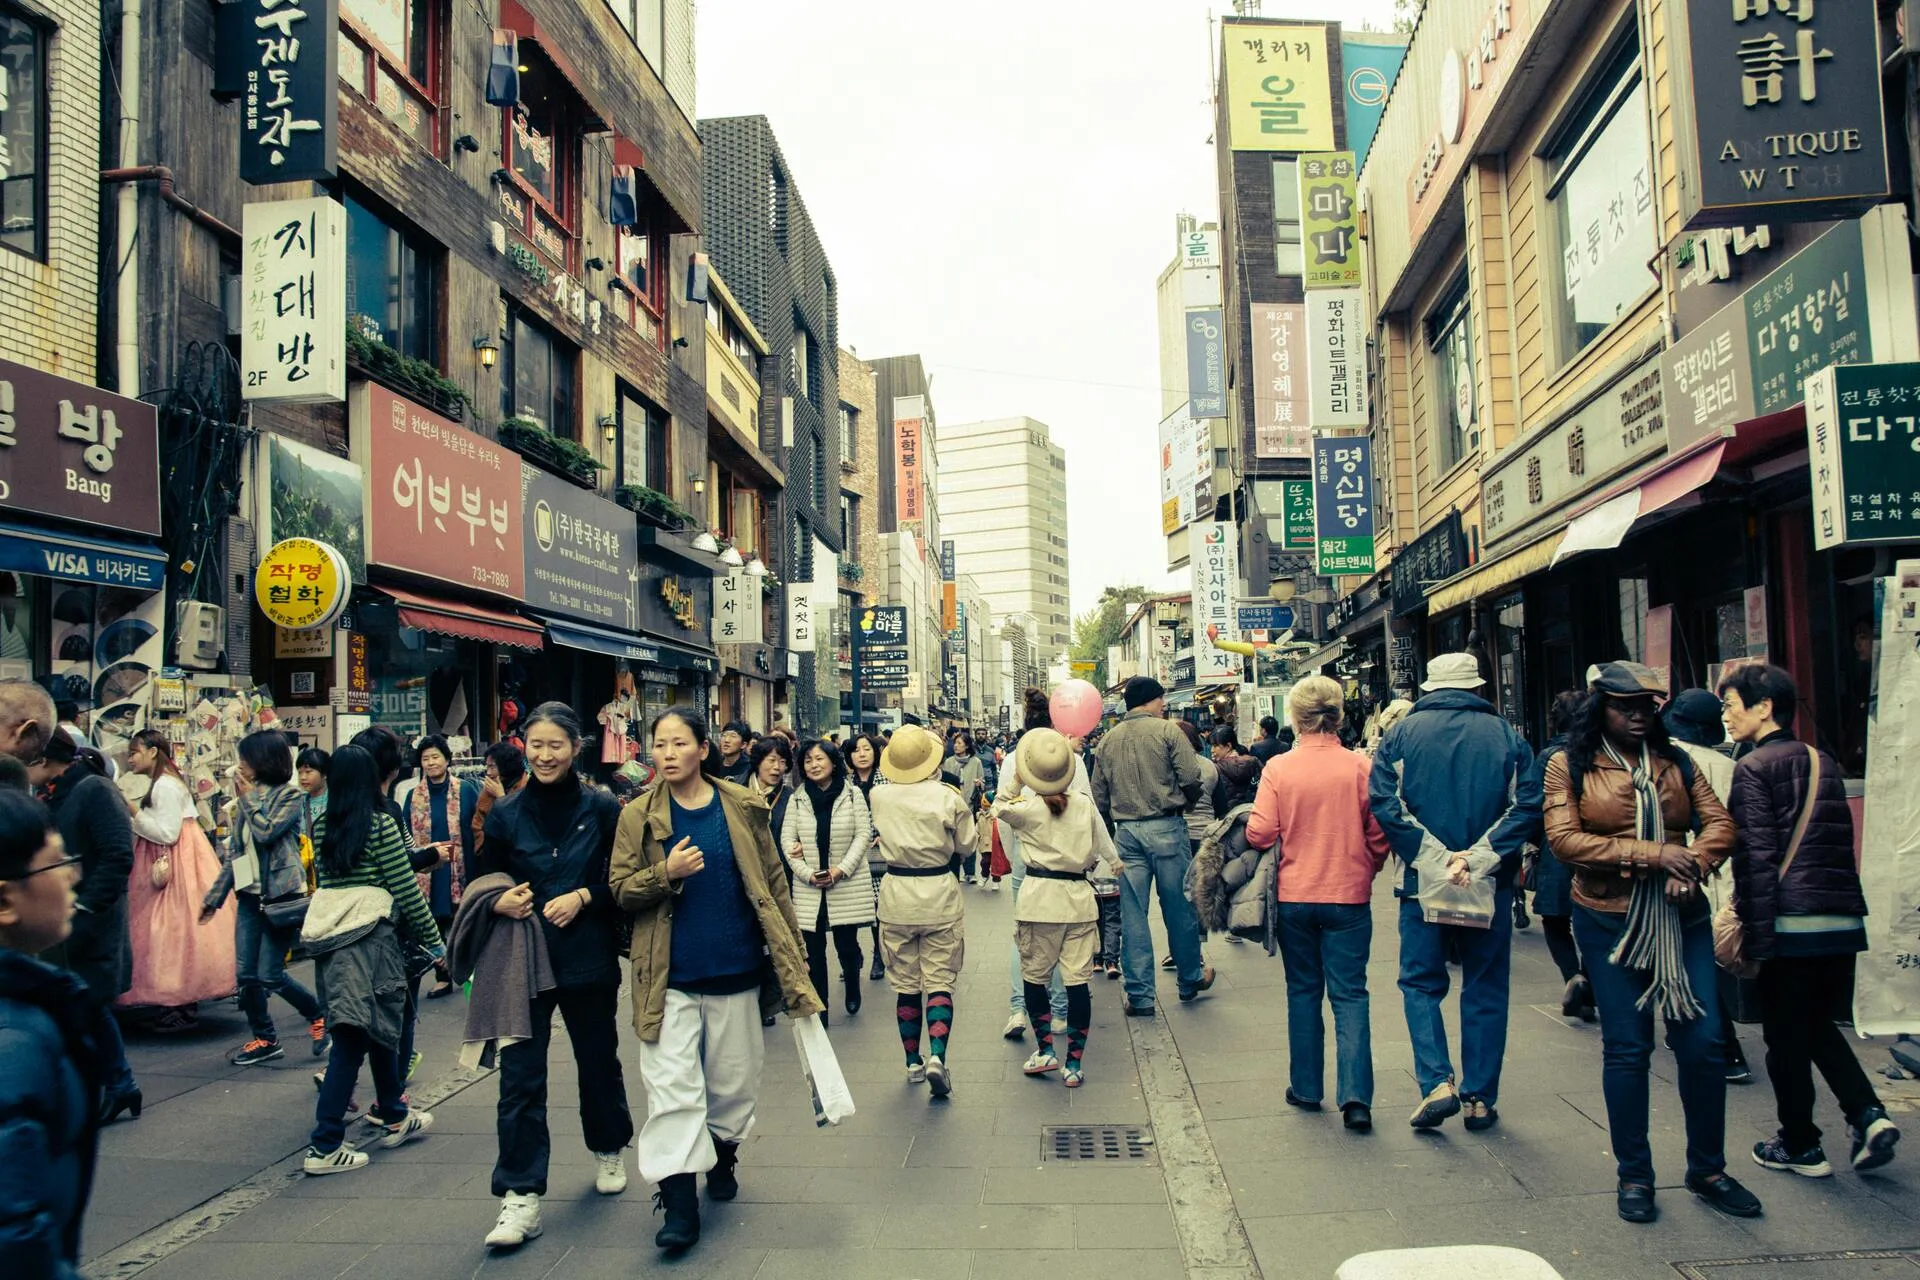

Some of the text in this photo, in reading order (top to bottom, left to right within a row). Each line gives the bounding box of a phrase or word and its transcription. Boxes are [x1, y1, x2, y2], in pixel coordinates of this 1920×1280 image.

[1243, 39, 1311, 64] 갤러리
[1308, 269, 1358, 281] 고미술 2F
[273, 211, 316, 382] 지대방
[1757, 271, 1850, 357] 다경향실
[1327, 299, 1349, 414] 평화아트갤러리
[1673, 330, 1734, 394] 평화아트
[247, 370, 268, 387] 2F
[1691, 368, 1737, 426] 갤러리
[411, 415, 439, 441] 천연의
[1813, 378, 1834, 539] 전통찻집
[65, 468, 112, 503] Bang
[1333, 446, 1368, 529] 명신당
[1321, 540, 1347, 554] 월간
[1322, 556, 1373, 570] 아트앤씨
[269, 563, 322, 581] 작명
[269, 585, 325, 606] 철학
[721, 576, 738, 636] 인사동
[794, 595, 809, 640] 옛찻집
[874, 618, 903, 638] 마루
